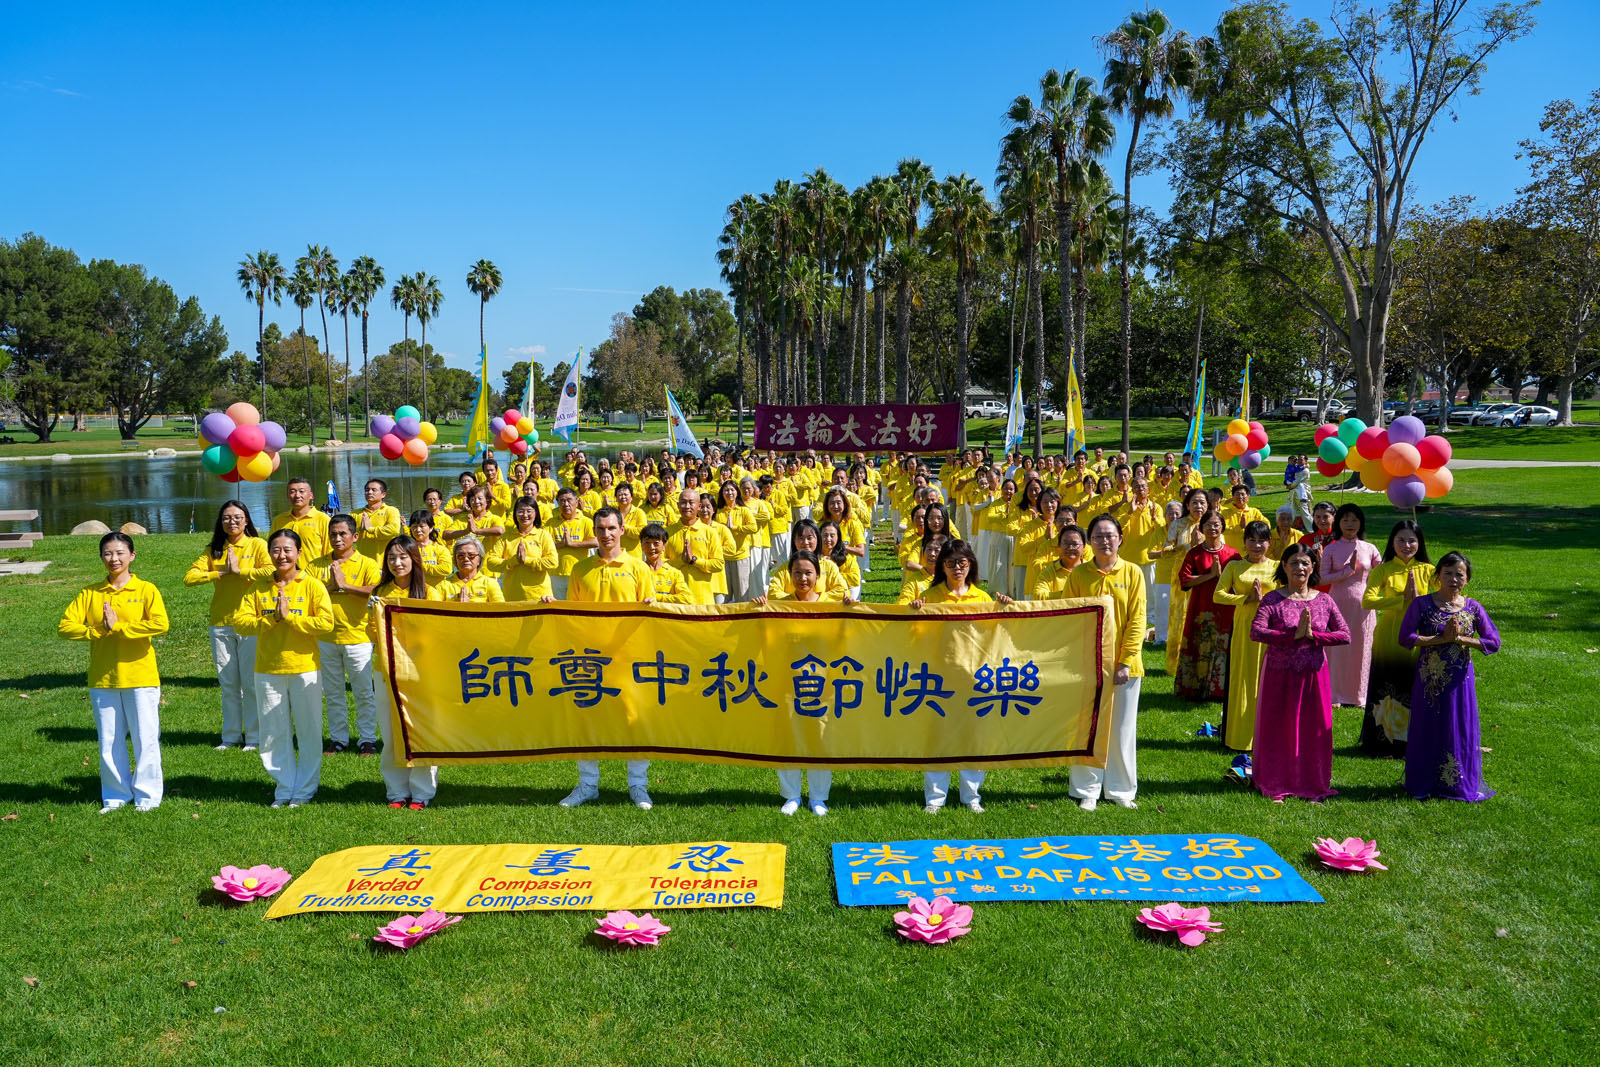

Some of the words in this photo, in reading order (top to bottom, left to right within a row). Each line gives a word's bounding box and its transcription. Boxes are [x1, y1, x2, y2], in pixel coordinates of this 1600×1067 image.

[768, 410, 938, 447] 法輪大法好
[458, 648, 1043, 719] 師尊中秋節快樂
[358, 848, 432, 877] 真
[504, 847, 591, 876] 善
[667, 845, 745, 873] 忍
[846, 838, 1256, 866] 法輪大法好
[346, 878, 424, 892] Verdad
[479, 878, 594, 892] Compasion
[649, 875, 758, 890] Tolerancia
[850, 870, 983, 886] FALUN
[996, 866, 1106, 883] DAFA
[1112, 866, 1151, 882] IS
[1162, 865, 1282, 881] GOOD
[299, 892, 434, 908] Truthfulness
[467, 894, 594, 908] Compassion
[653, 891, 756, 907] Tolerance
